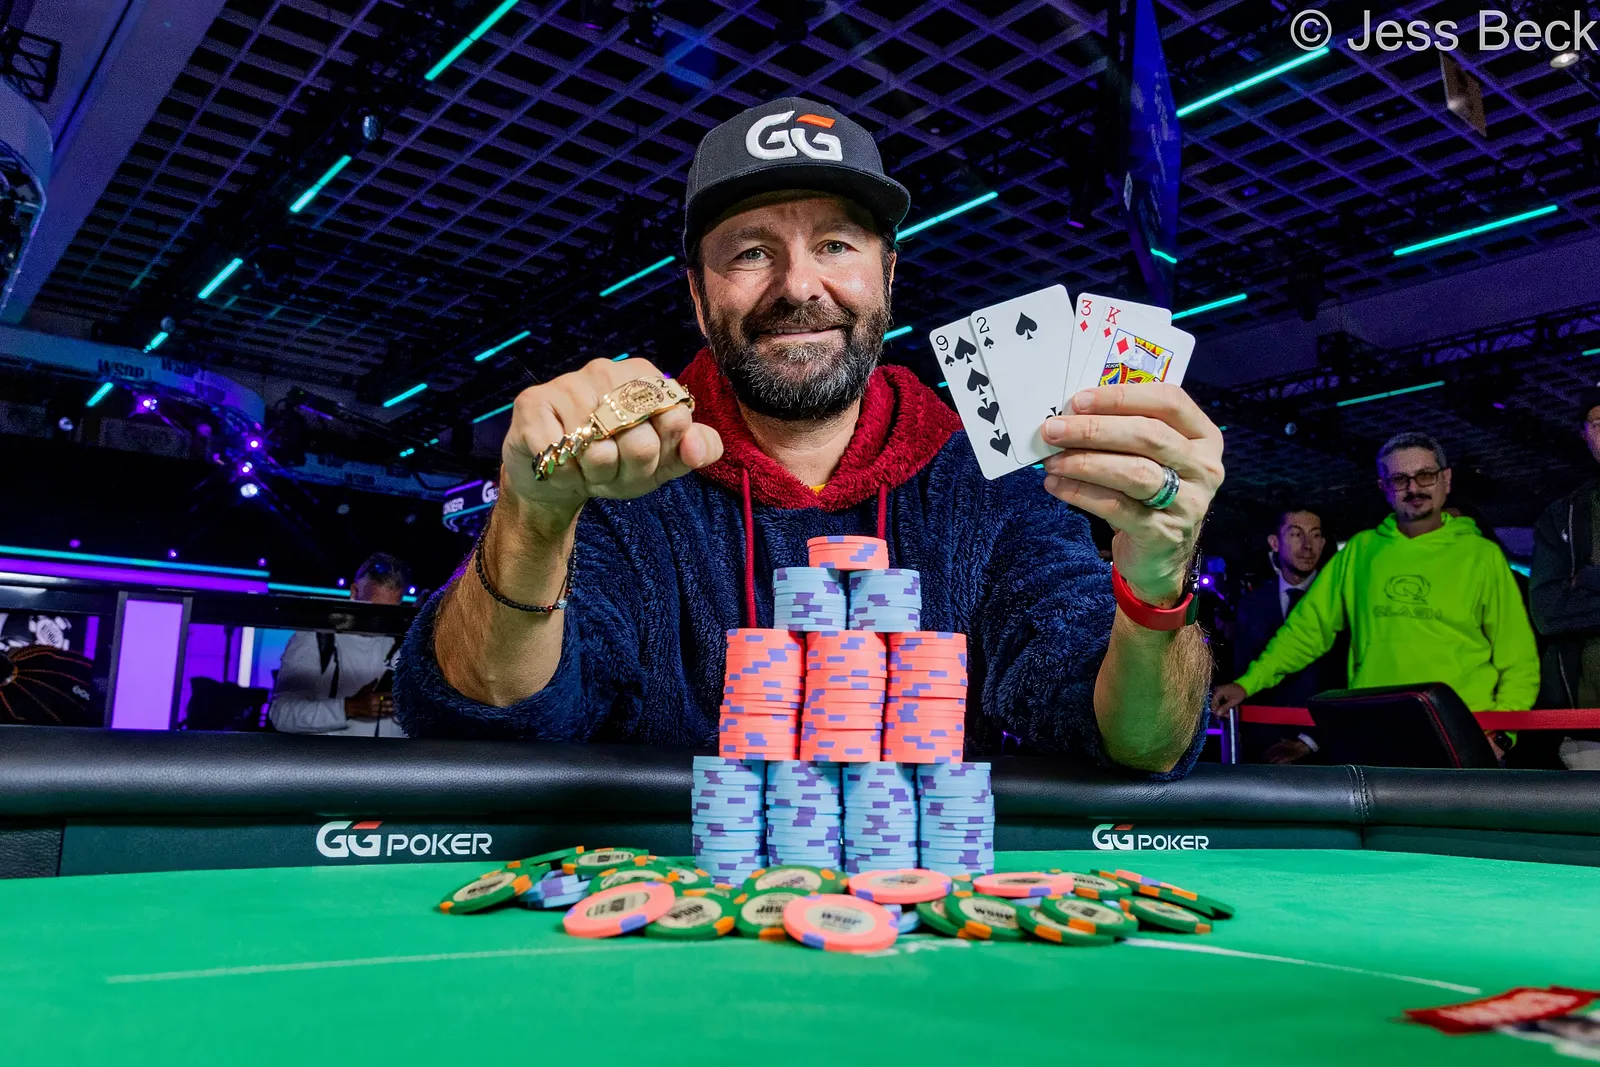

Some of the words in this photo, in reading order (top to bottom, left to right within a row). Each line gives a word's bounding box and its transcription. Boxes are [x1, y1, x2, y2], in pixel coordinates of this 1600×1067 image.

[745, 110, 843, 161] GG
[1081, 299, 1092, 316] 3
[1106, 306, 1121, 325] K
[976, 317, 990, 334] 2
[935, 335, 949, 351] 9
[387, 833, 492, 856] POKER
[1138, 834, 1209, 850] POKER
